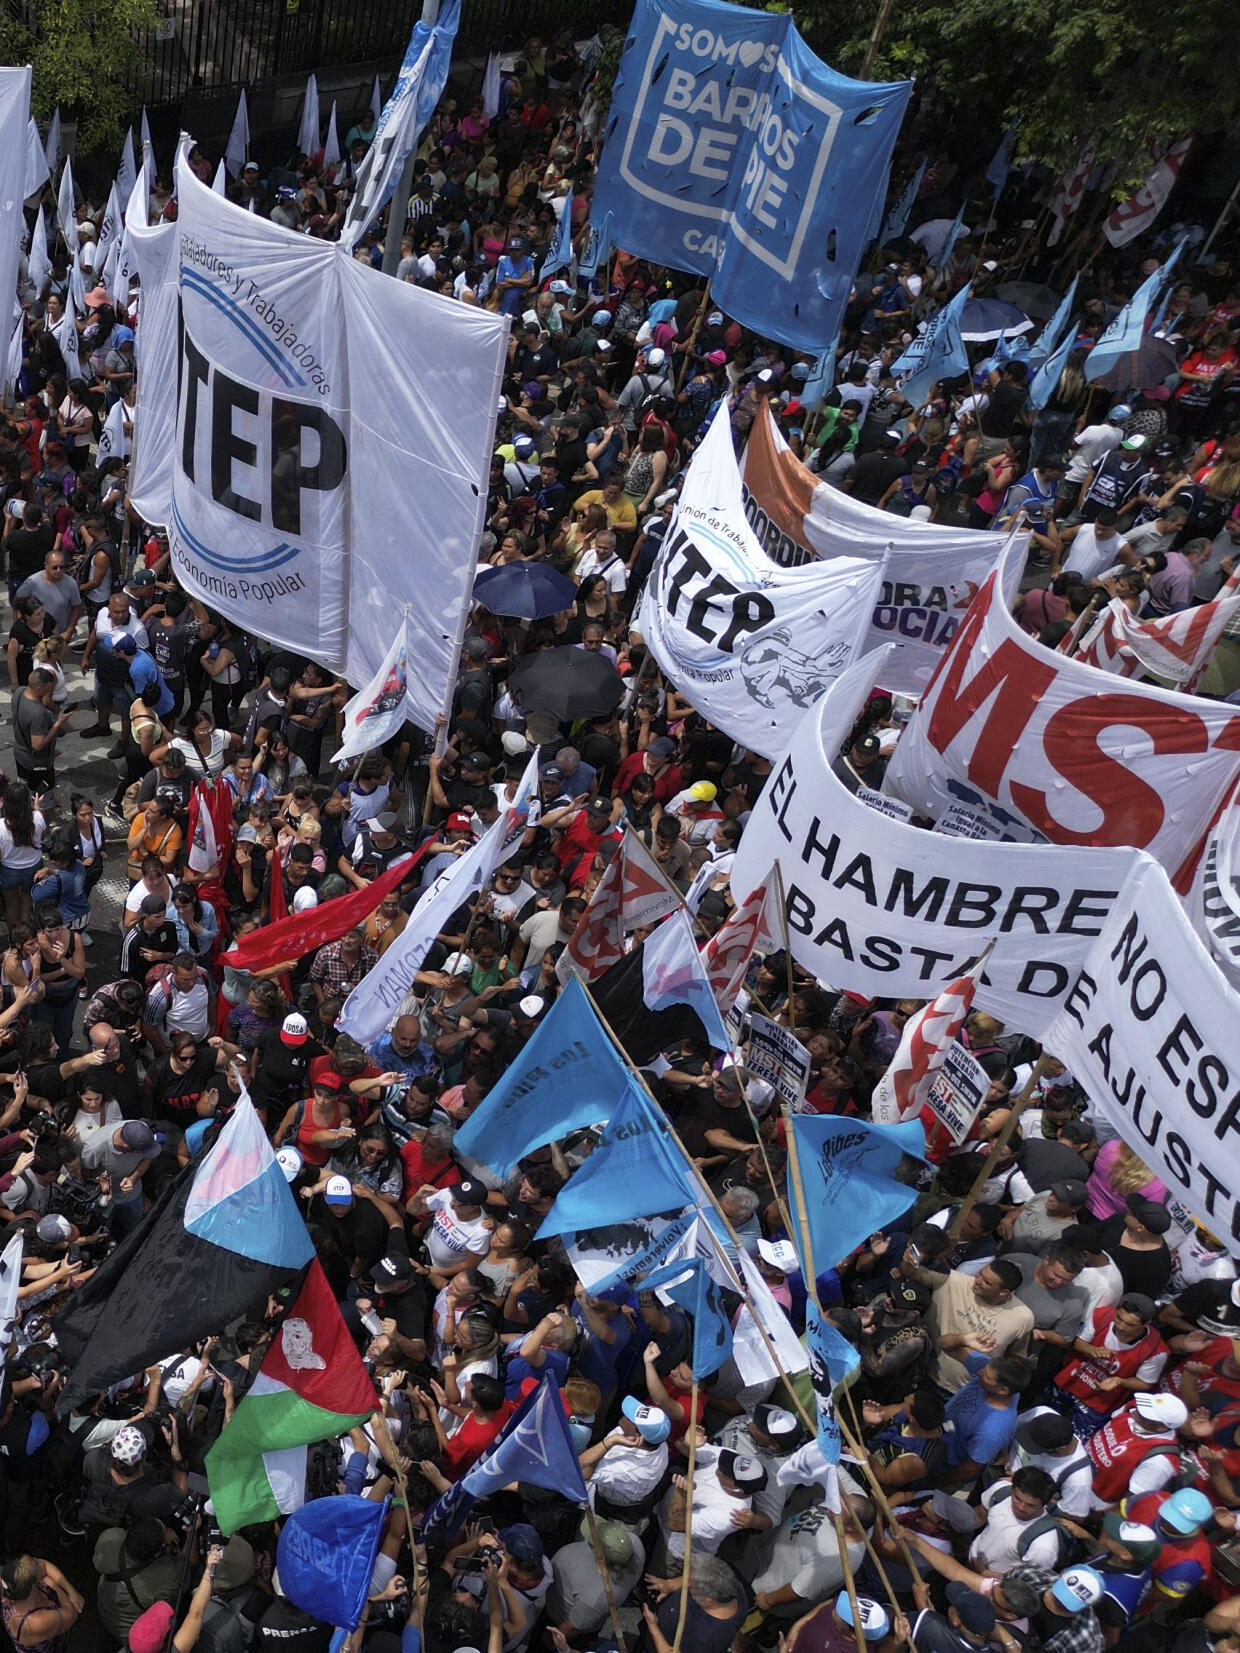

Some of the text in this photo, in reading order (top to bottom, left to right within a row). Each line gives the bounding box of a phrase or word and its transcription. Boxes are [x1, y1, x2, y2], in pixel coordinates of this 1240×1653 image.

[664, 67, 800, 171] BARRIOS
[647, 112, 788, 230] DE PIE
[231, 274, 246, 295] y
[246, 280, 330, 395] Trabajadoras
[178, 295, 347, 536] TEP
[708, 516, 720, 530] de
[173, 541, 237, 600] Economía
[239, 572, 307, 605] Popular
[919, 569, 1240, 850] MS
[858, 791, 909, 818] Salario Mínimo
[941, 819, 969, 839] Canasta
[949, 804, 1001, 835] Salario Mínimo
[769, 753, 797, 843] EL
[801, 815, 1119, 937] HAMBRE
[786, 883, 1097, 1030] BASTA DE
[1111, 910, 1167, 1022] NO
[745, 1060, 779, 1088] TERESA
[779, 1081, 800, 1105] VIVE
[750, 1044, 782, 1076] MST
[822, 1129, 871, 1160] Pibes
[947, 1109, 965, 1134] VIVE
